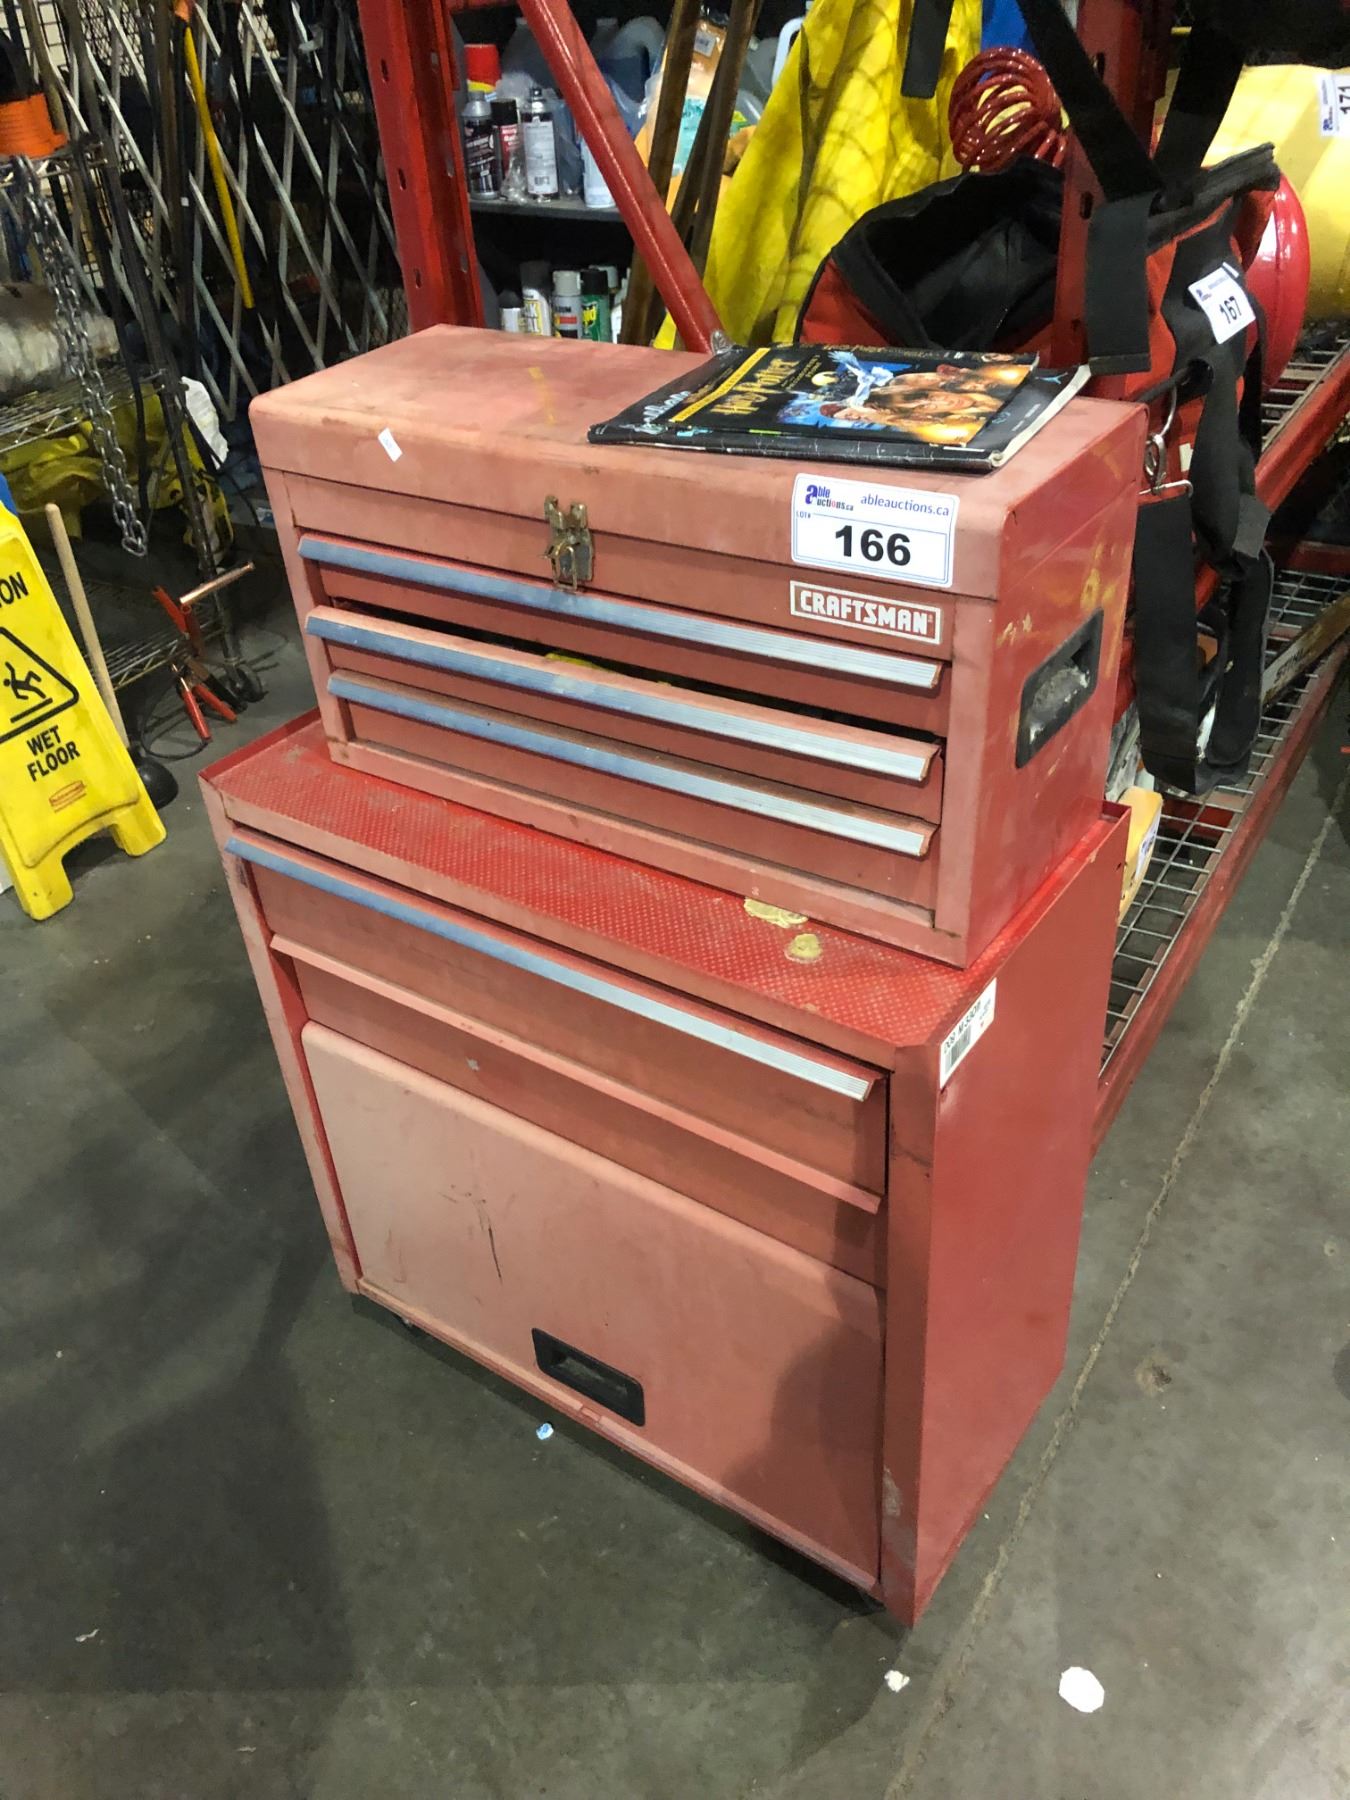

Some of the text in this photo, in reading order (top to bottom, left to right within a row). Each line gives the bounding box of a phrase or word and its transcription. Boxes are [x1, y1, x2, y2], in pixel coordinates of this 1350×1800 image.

[1219, 295, 1242, 324] 167
[860, 494, 950, 516] ableauctions.ca
[835, 524, 911, 566] 166
[0, 571, 29, 608] ON
[800, 590, 928, 635] CRAFTSMAN
[26, 724, 61, 756] WET
[27, 741, 81, 782] FLOOR
